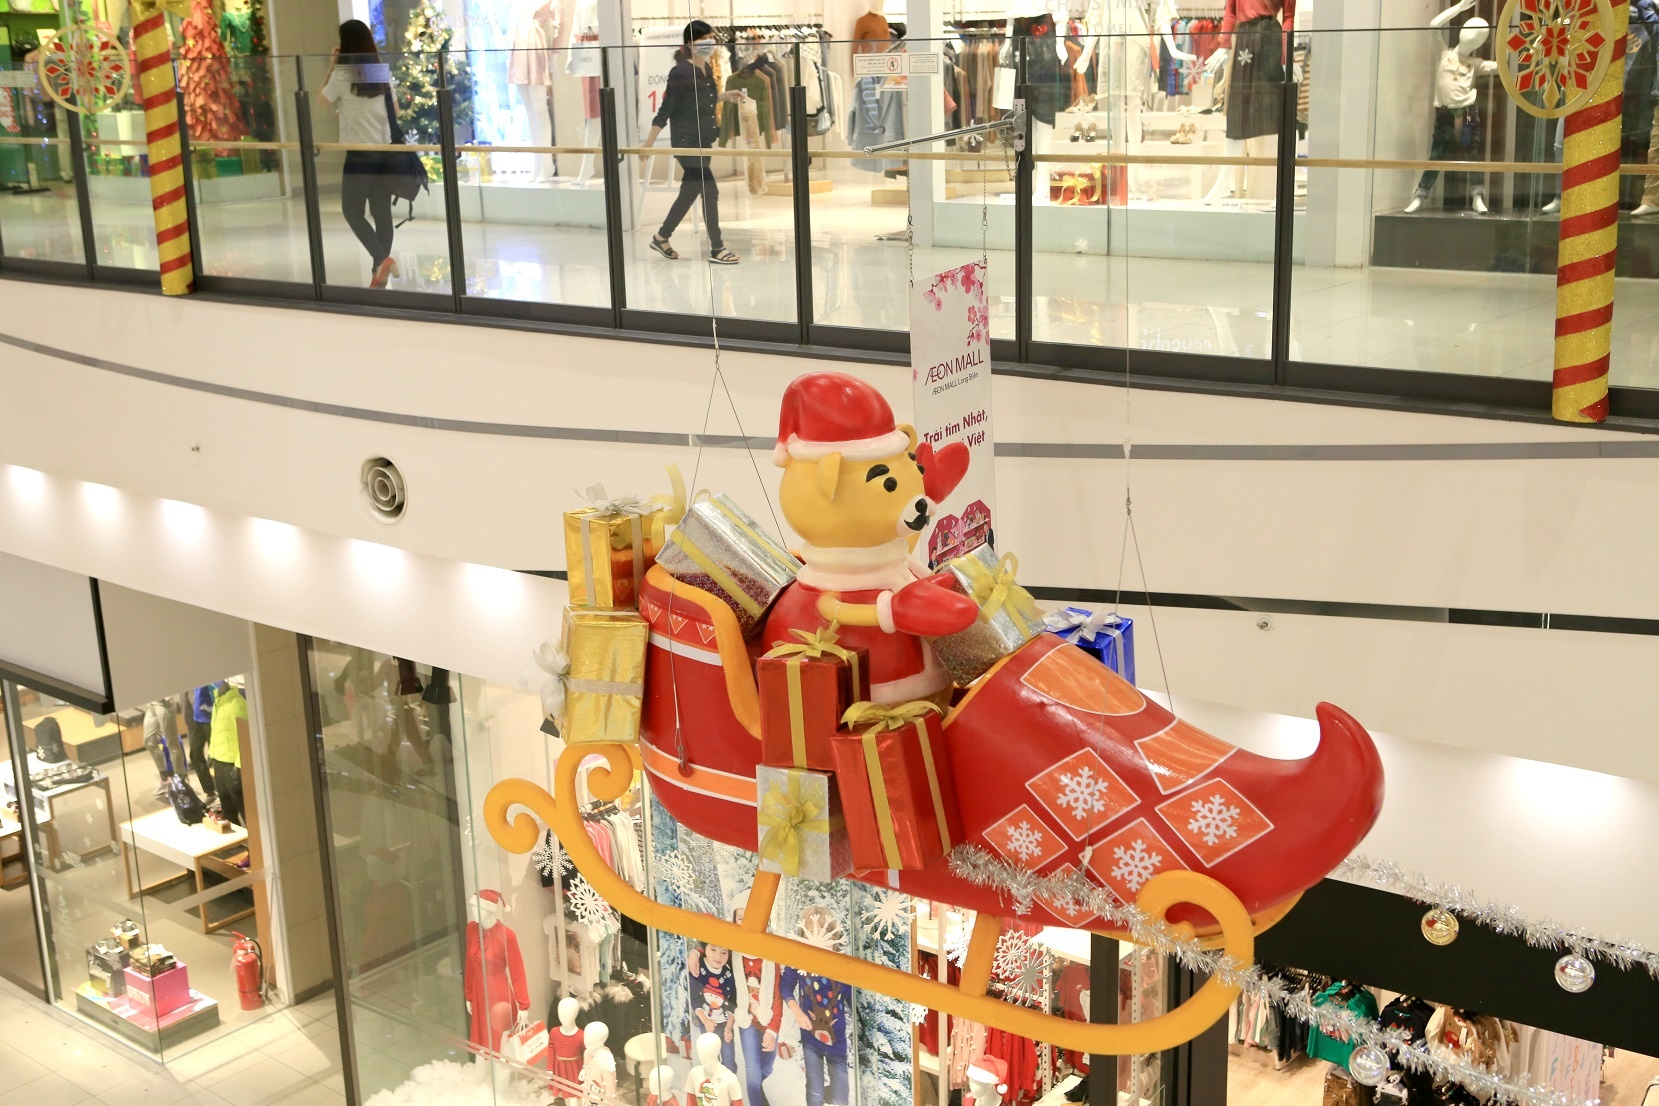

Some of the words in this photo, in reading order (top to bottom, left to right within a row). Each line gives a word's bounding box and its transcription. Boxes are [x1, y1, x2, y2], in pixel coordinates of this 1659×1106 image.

[648, 73, 668, 85] ĐÔN
[955, 349, 984, 373] MALL
[945, 381, 958, 391] MALL
[958, 376, 969, 385] Long
[924, 427, 943, 444] Trái
[945, 423, 960, 437] tim
[963, 409, 988, 429] Nhật,
[967, 430, 985, 448] Việt
